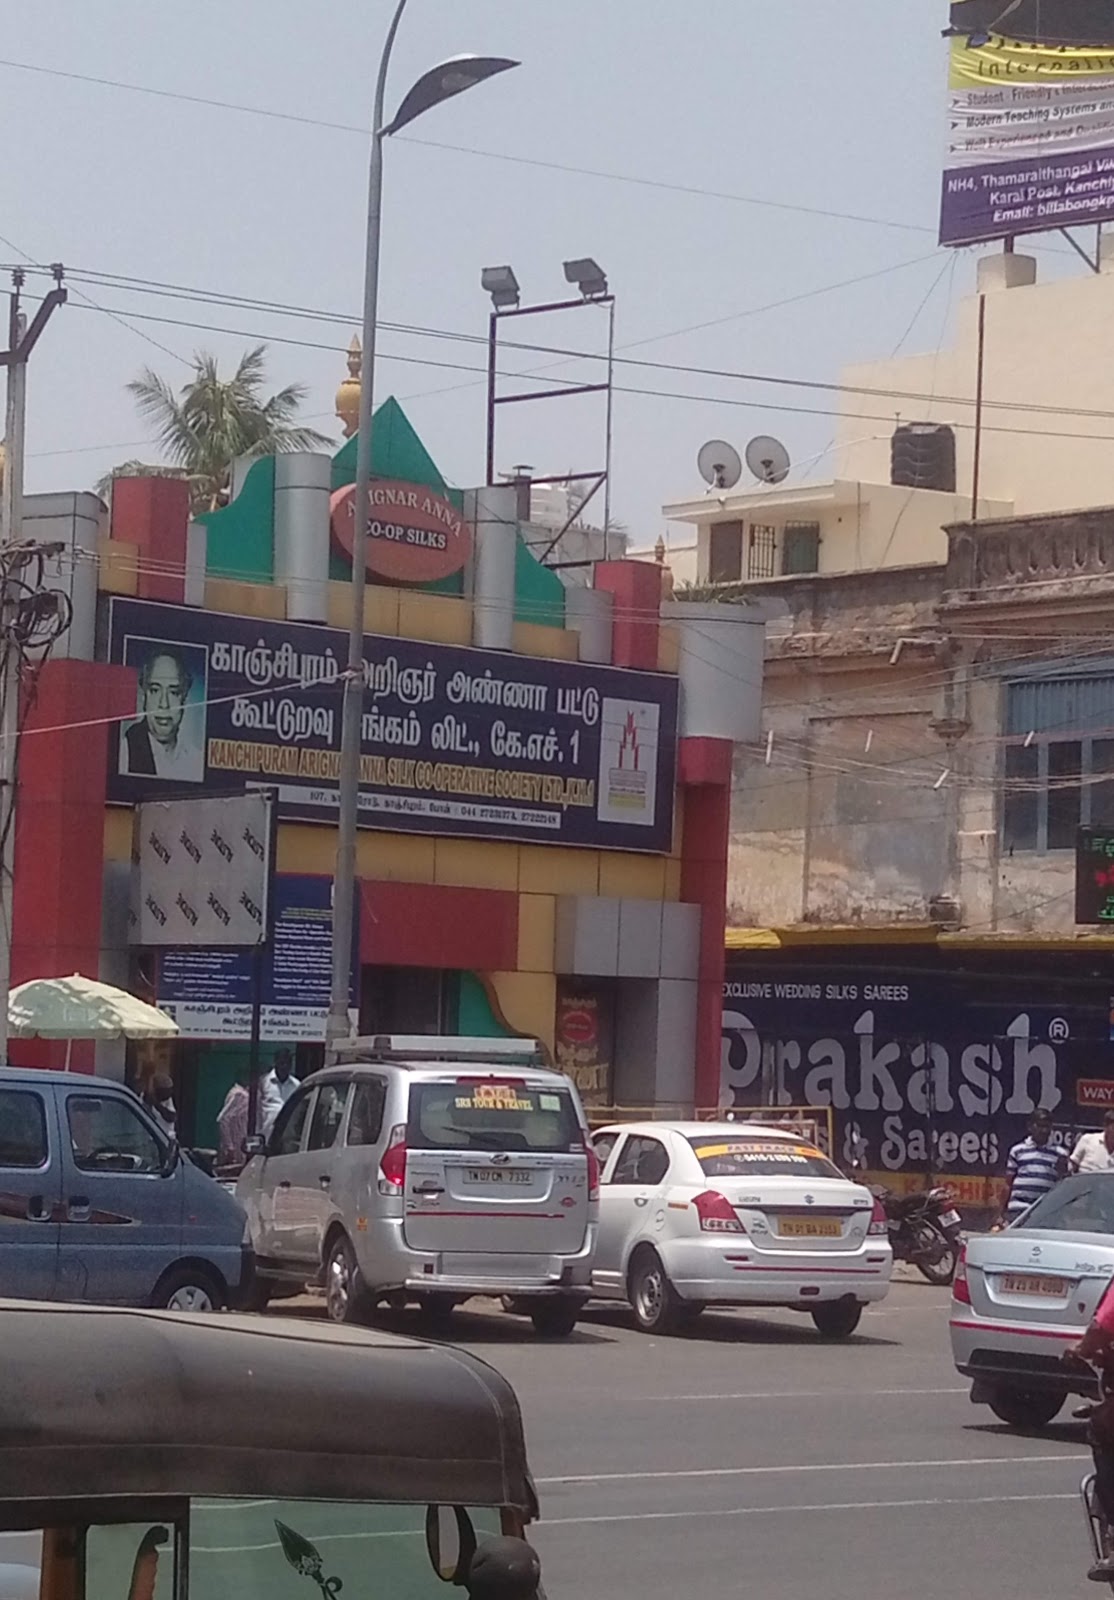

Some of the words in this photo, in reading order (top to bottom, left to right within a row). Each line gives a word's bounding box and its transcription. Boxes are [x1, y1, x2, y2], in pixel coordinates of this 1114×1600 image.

[966, 114, 1002, 128] Modern
[1004, 107, 1050, 122] Teaching
[1052, 103, 1097, 120] Systems
[967, 91, 1004, 106] Student
[421, 497, 462, 538] ANNA
[406, 528, 447, 550] SILKS
[210, 638, 339, 690] காஞ்சிபுரம்
[446, 668, 548, 713] அண்ணா
[556, 686, 600, 726] பட்டு
[231, 697, 334, 745] கூட்டுறவு
[361, 704, 421, 747] ங்கம்
[208, 739, 299, 776] KANCHIPURAM
[360, 754, 387, 785] NNA
[387, 757, 416, 788] SILK
[495, 769, 541, 801] SOCIETY
[774, 983, 822, 998] WEDDING
[825, 984, 858, 999] SILKS
[863, 985, 910, 1000] SAREES
[718, 1009, 1062, 1118] Prakash
